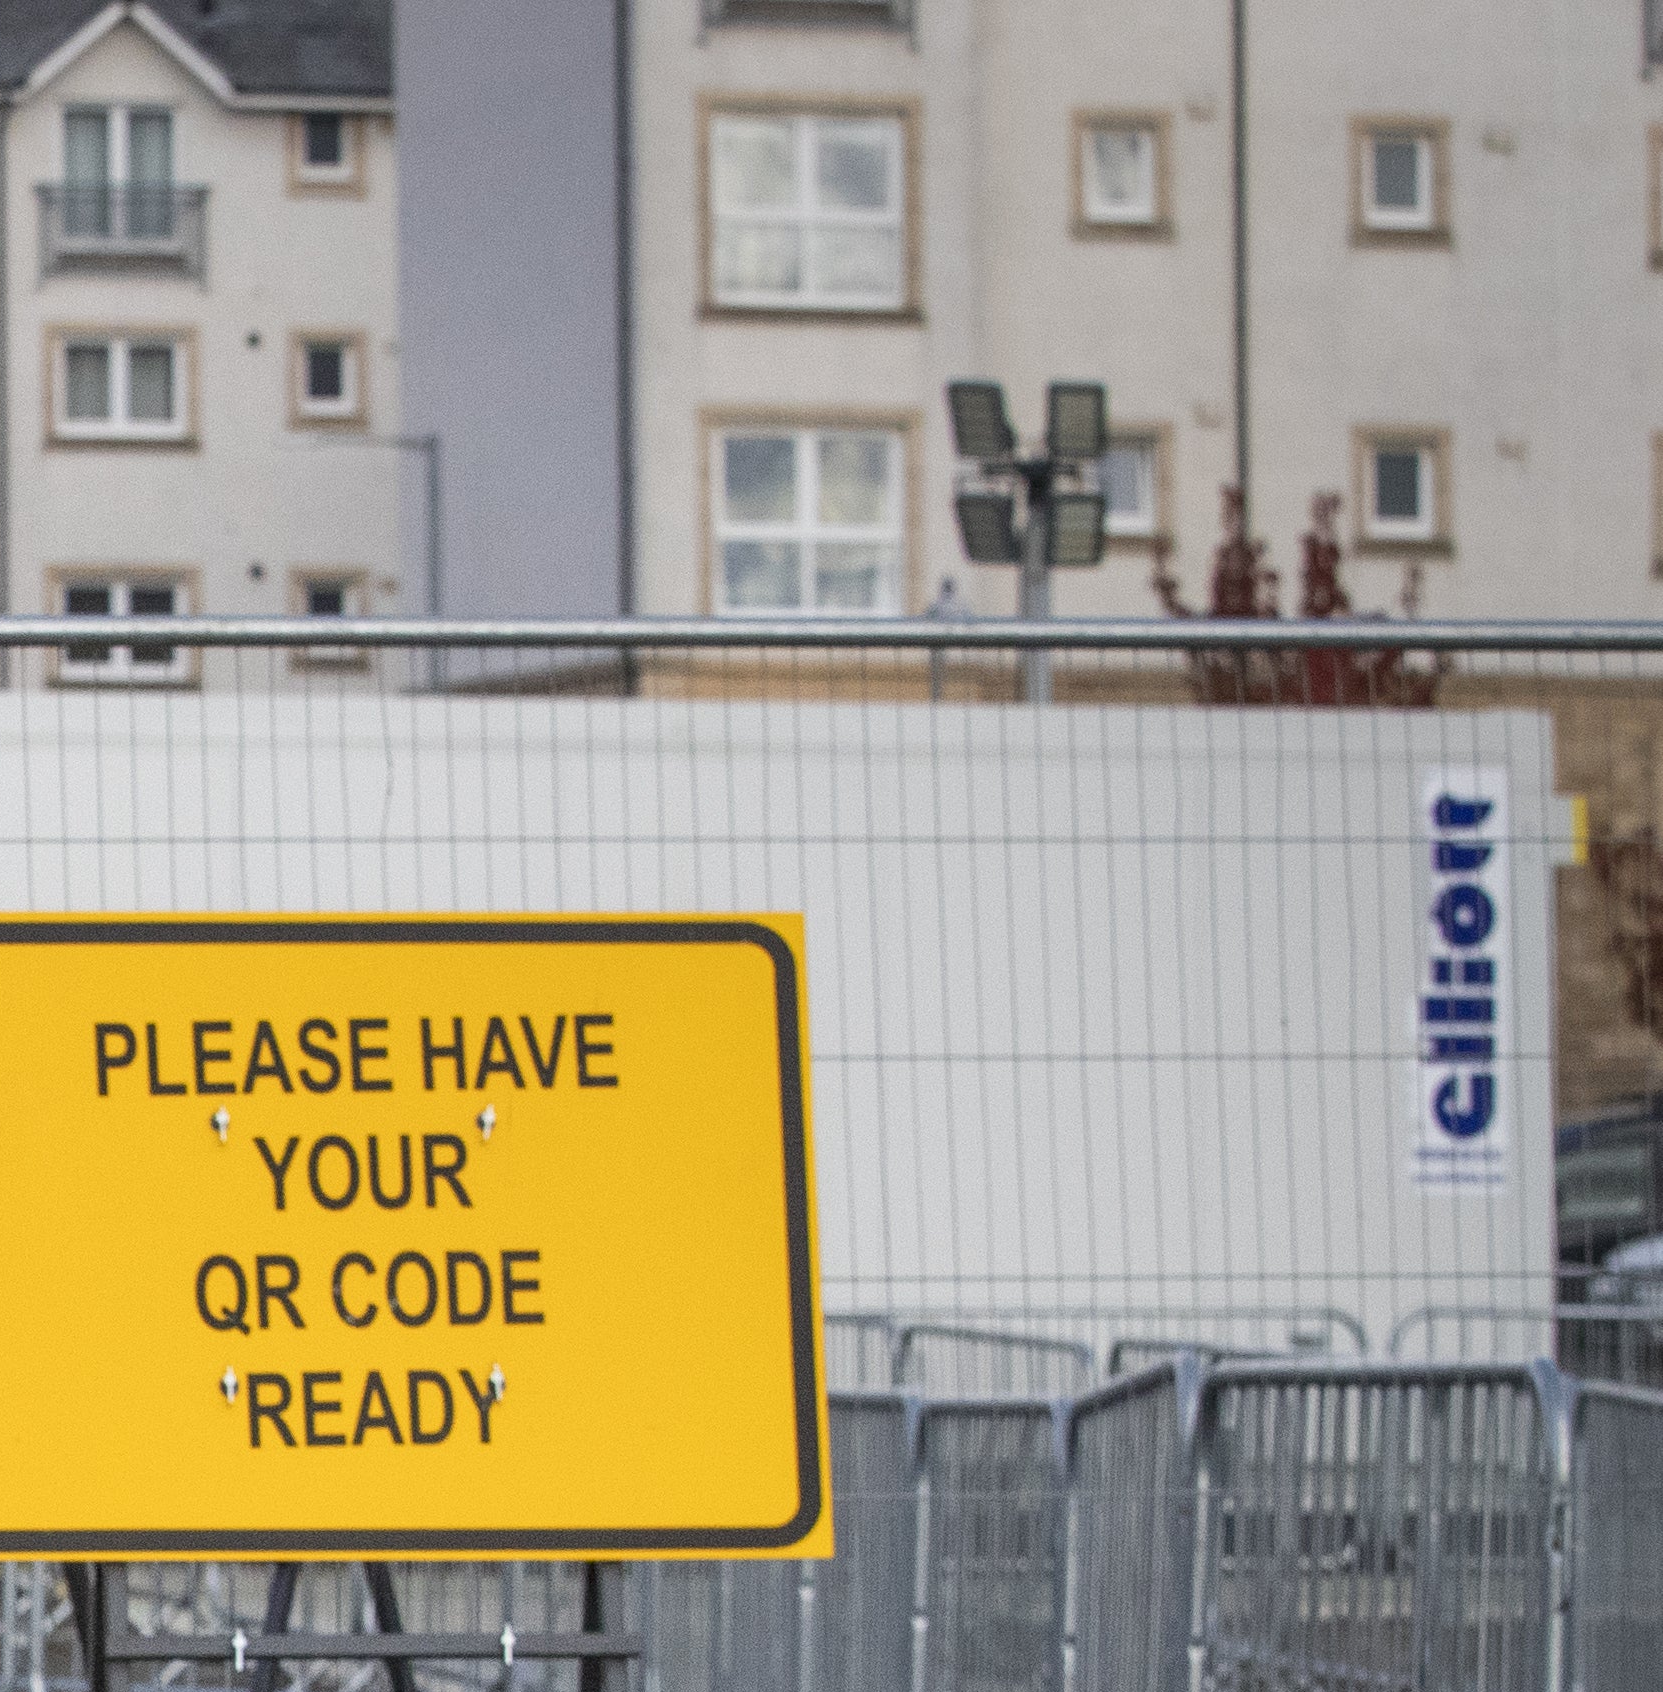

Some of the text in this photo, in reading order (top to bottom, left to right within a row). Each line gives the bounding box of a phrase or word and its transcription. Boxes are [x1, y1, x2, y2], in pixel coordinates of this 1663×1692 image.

[95, 1014, 619, 1096] PLEASE HAVE
[252, 1134, 473, 1210] YOUR
[195, 1250, 545, 1334] QR CODE
[247, 1369, 501, 1447] READY
